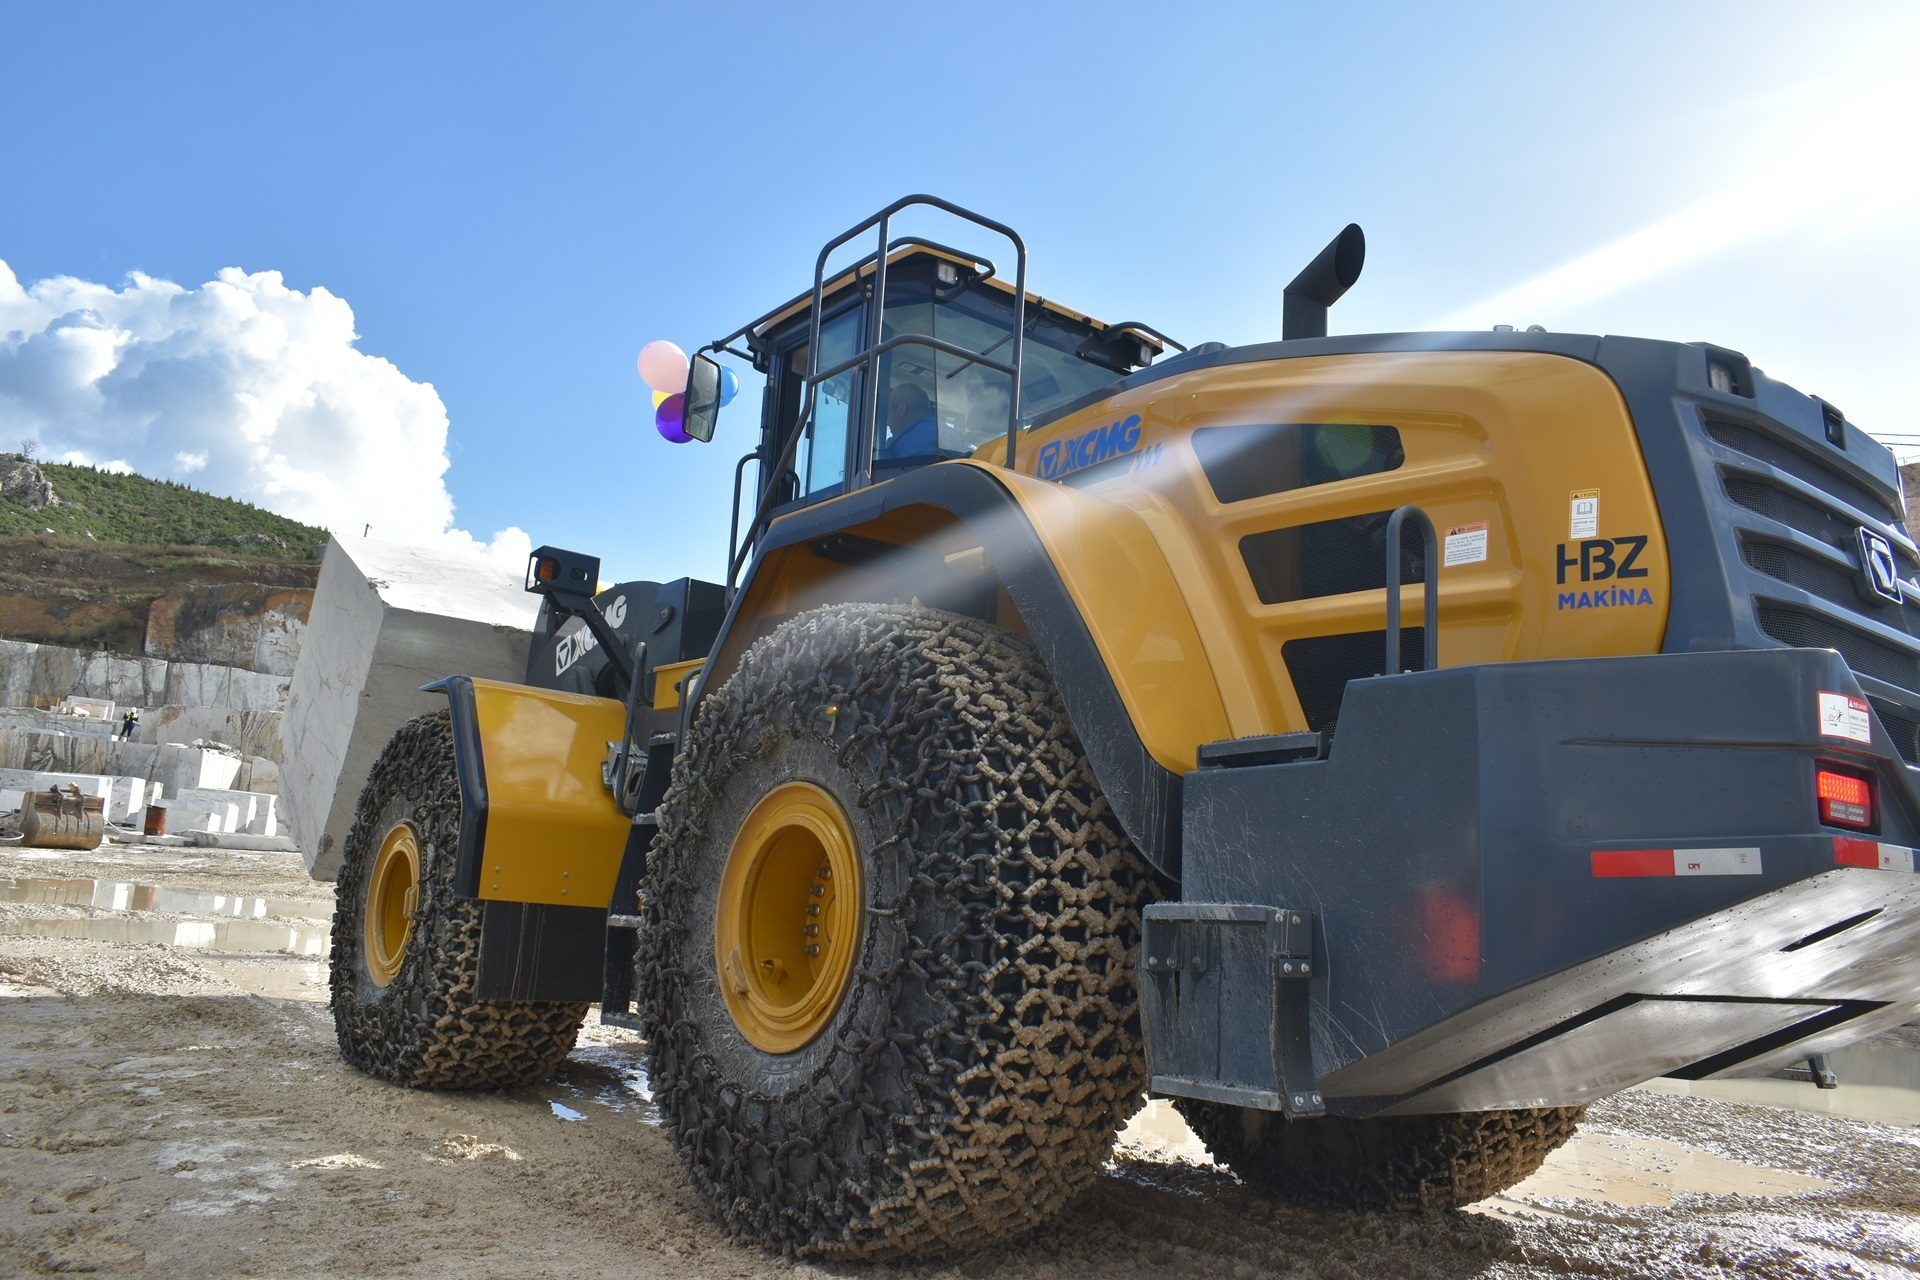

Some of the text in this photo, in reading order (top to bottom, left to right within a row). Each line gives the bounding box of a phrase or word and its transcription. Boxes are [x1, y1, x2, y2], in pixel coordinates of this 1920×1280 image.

[1059, 414, 1142, 473] XCMG
[1557, 535, 1648, 584] HBZ
[1558, 585, 1653, 610] MAKİNA
[571, 594, 627, 664] XCG
